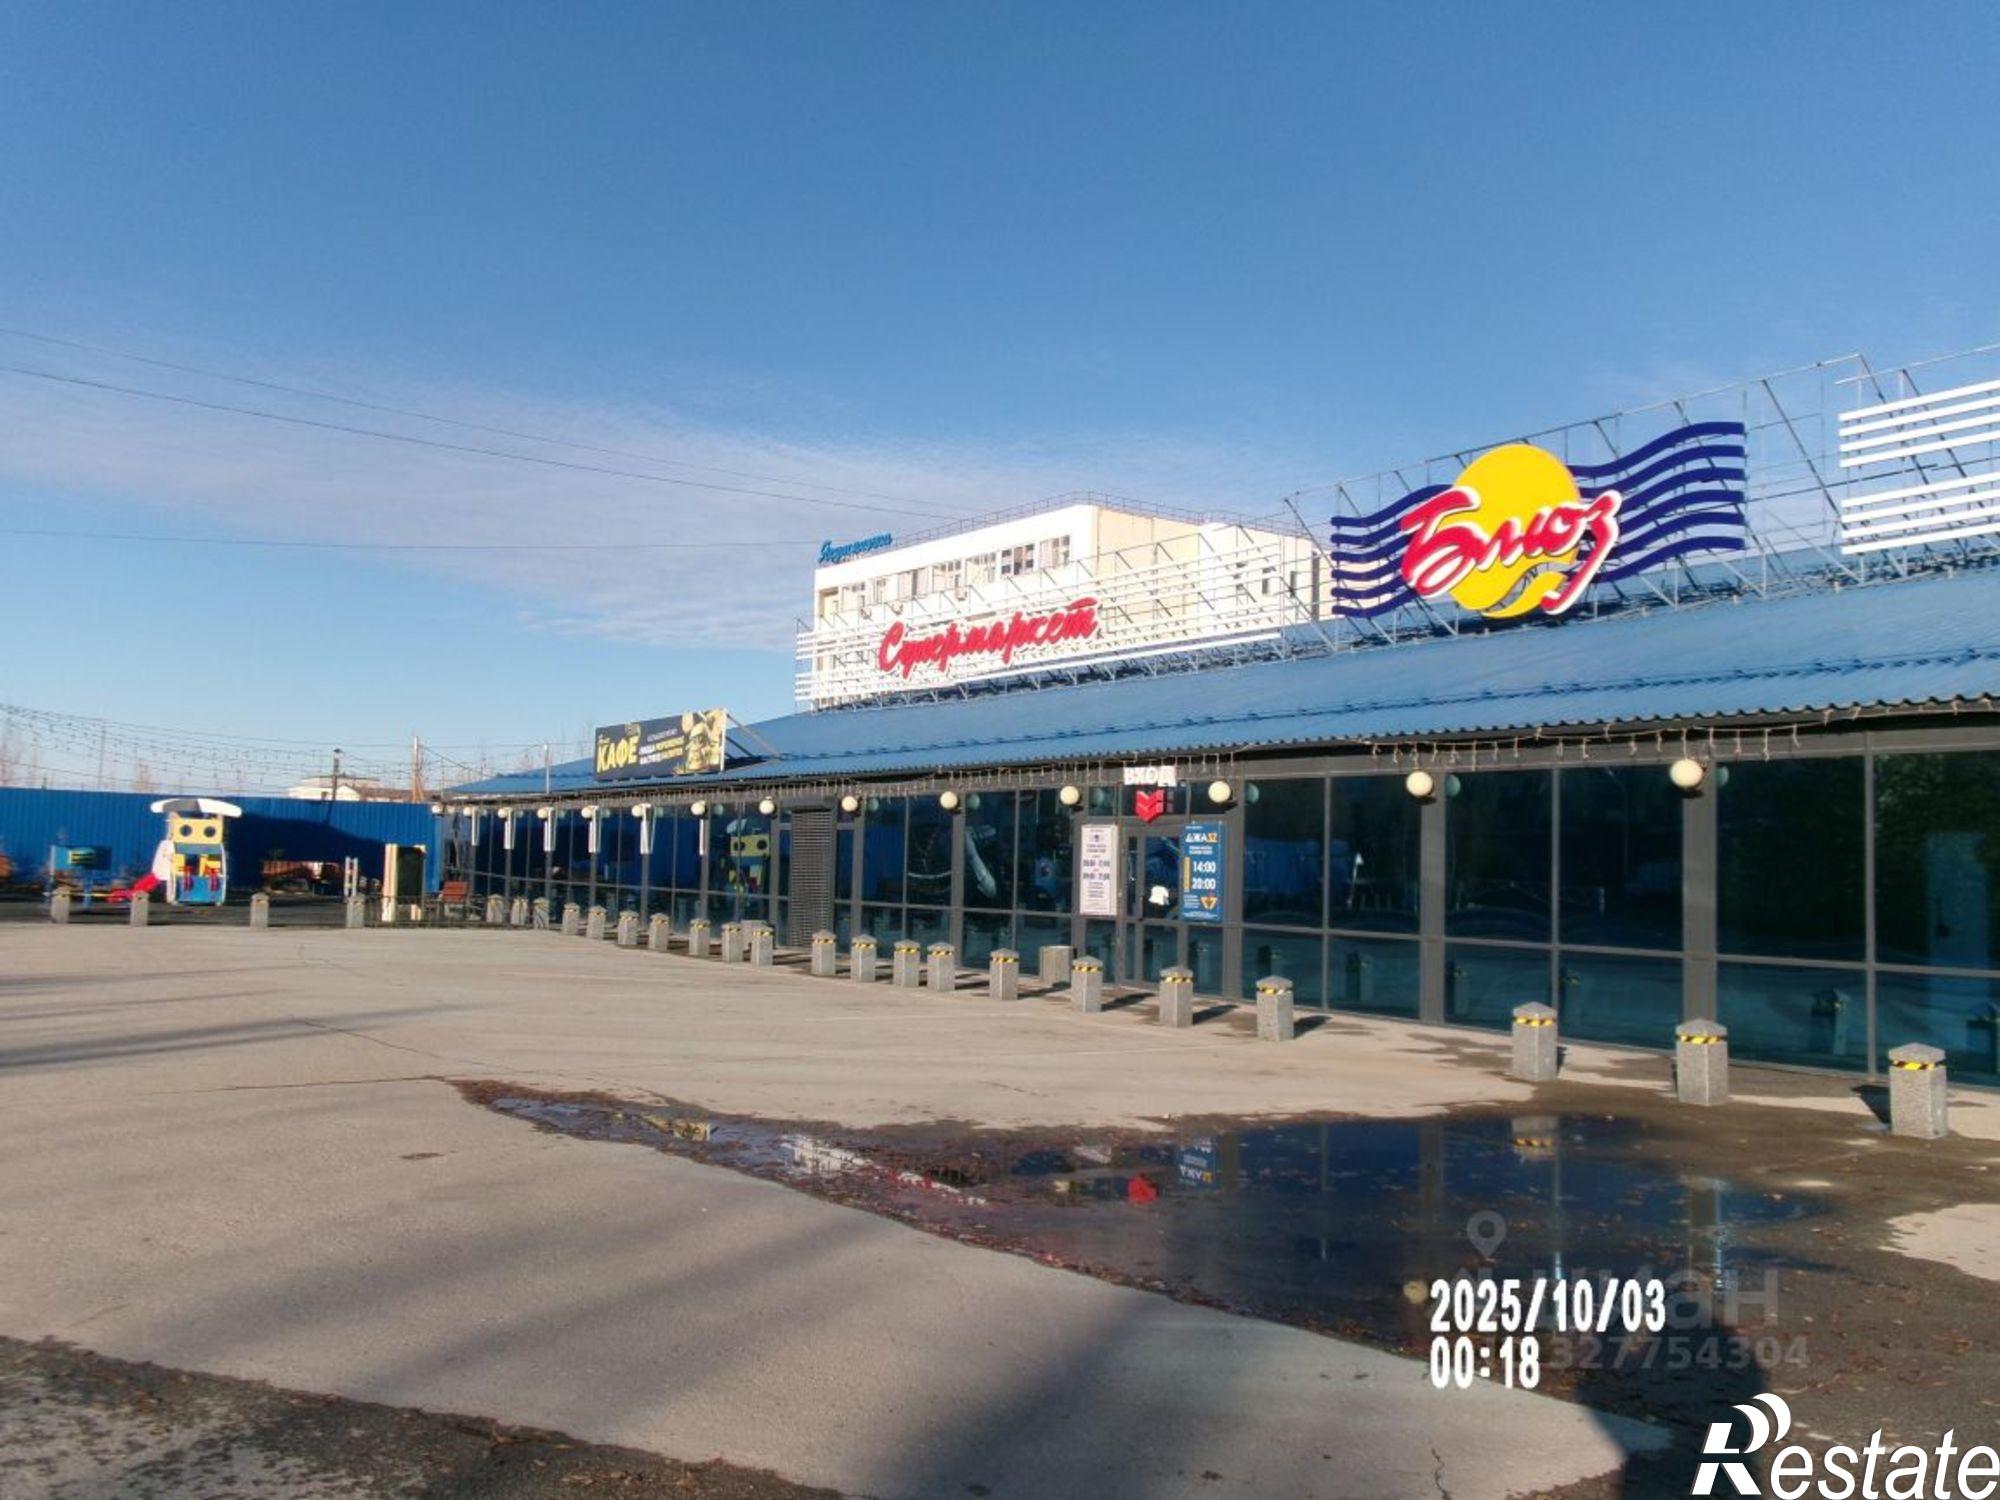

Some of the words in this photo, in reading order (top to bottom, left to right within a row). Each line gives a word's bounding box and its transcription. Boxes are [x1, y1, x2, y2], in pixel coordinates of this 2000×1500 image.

[1399, 486, 1622, 614] Блюз
[877, 596, 1099, 679] Супермаркет
[596, 735, 640, 774] КАФЕ
[1192, 861, 1216, 873] 14:00
[1192, 878, 1216, 890] 20:00
